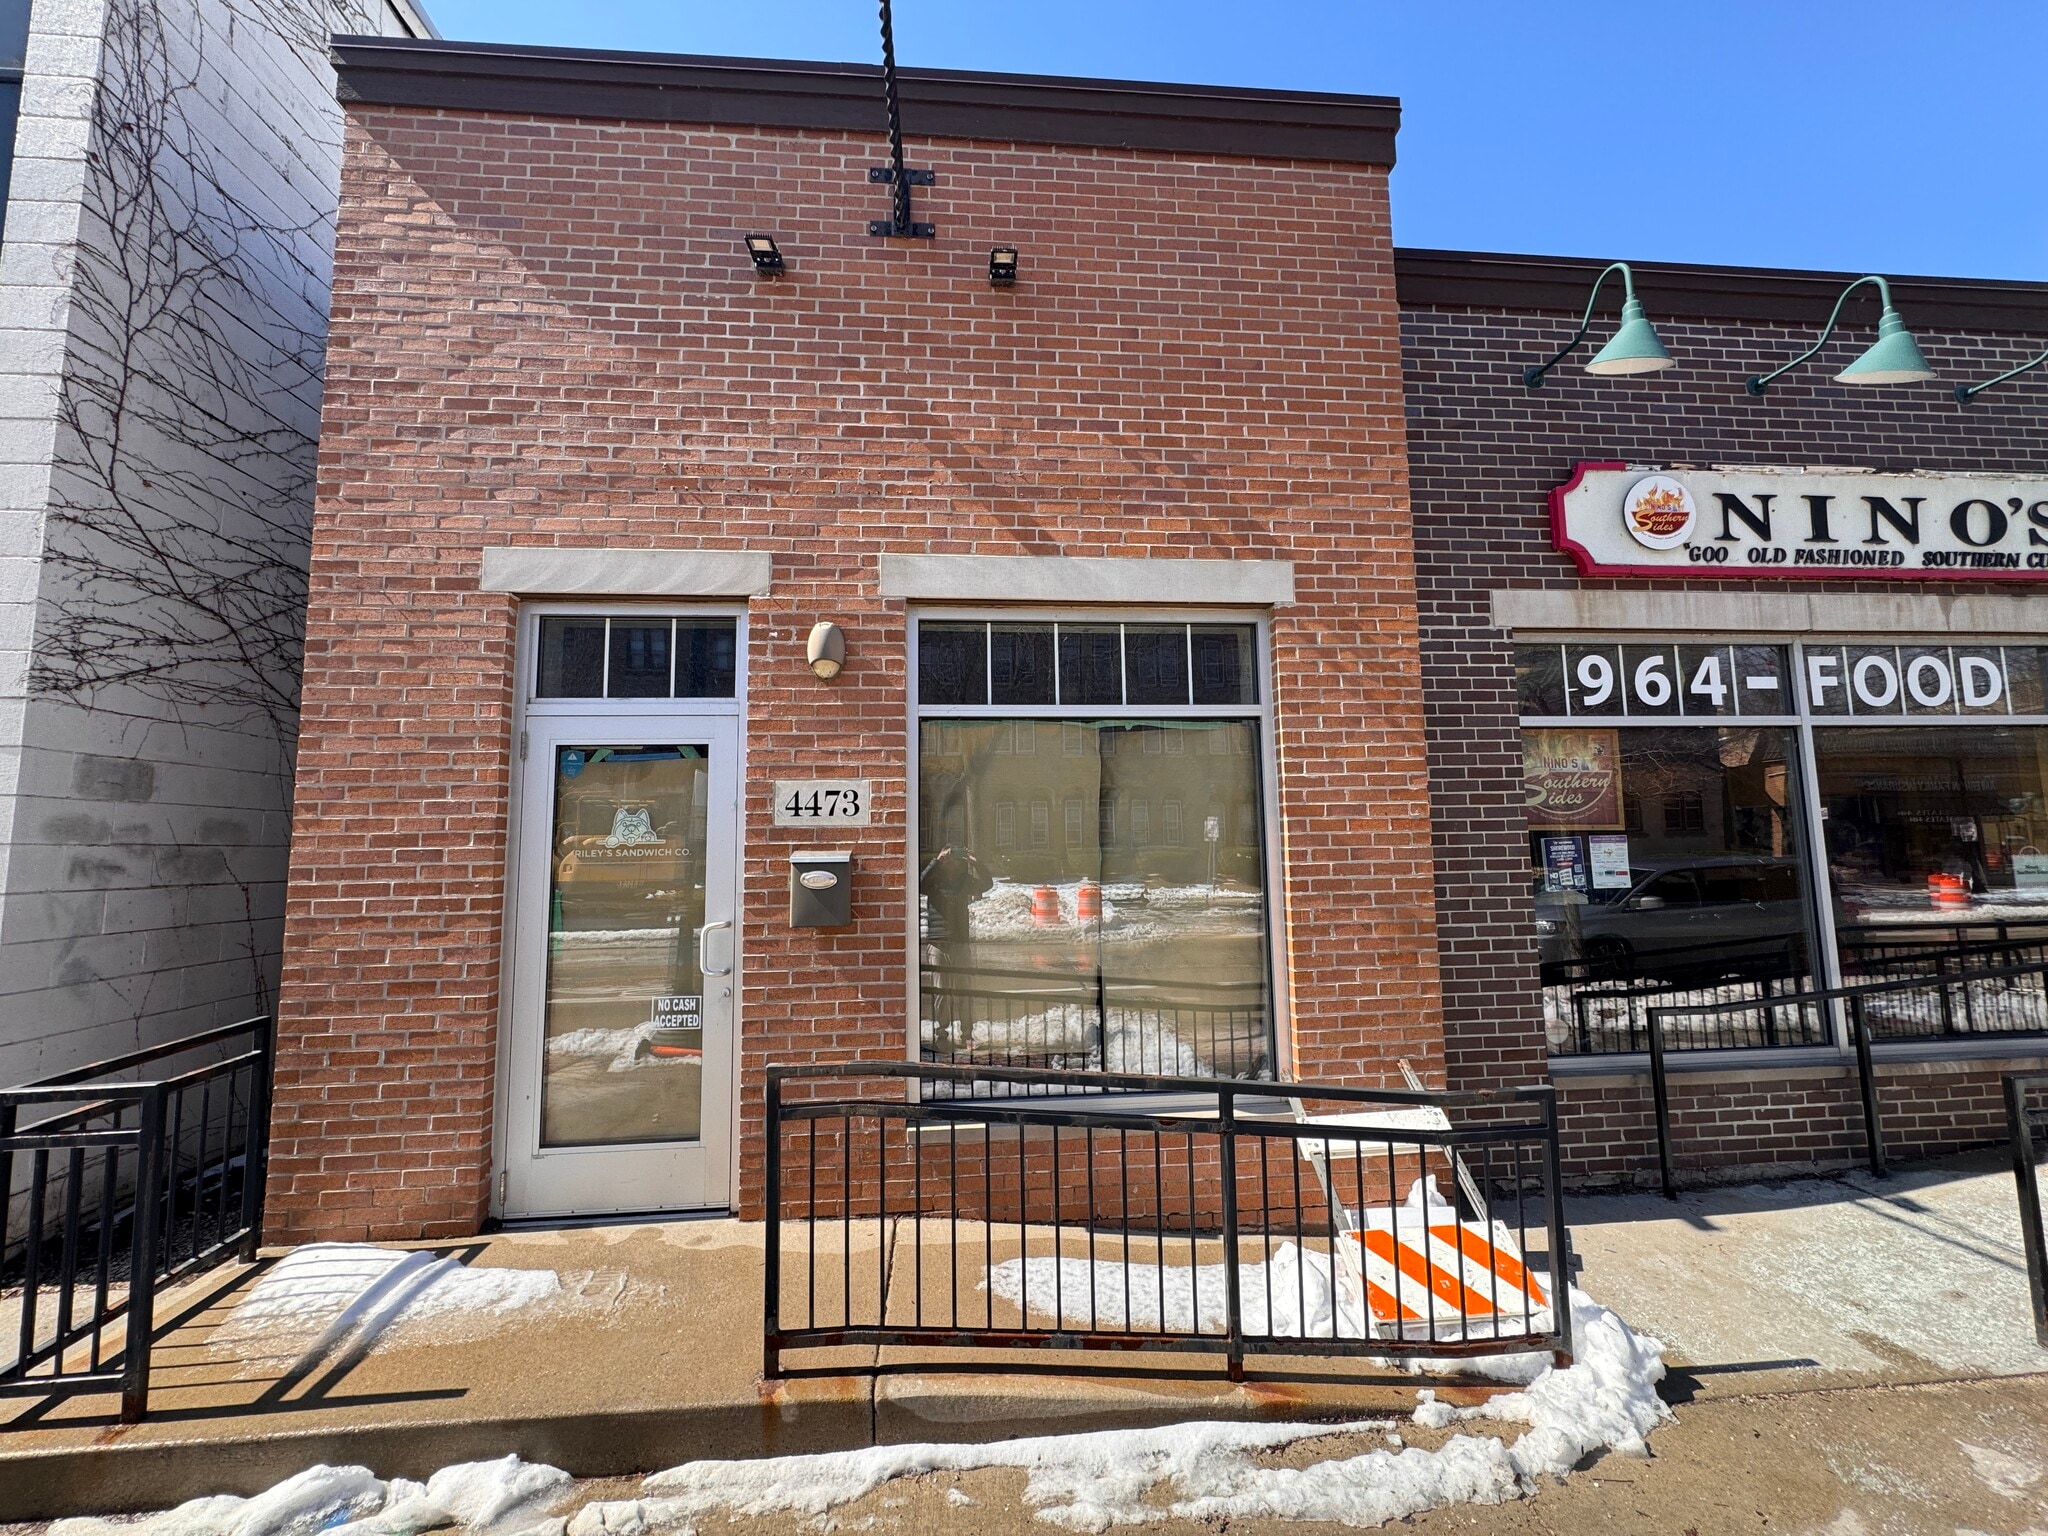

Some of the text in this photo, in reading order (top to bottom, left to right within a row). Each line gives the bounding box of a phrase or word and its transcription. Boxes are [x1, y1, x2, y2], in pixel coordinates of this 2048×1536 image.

[1747, 547, 1787, 564] OLD
[1793, 548, 1905, 566] FASHIONED
[1922, 551, 2021, 568] SOUTHERN
[1807, 655, 2003, 707] FOOD
[785, 789, 860, 818] 4473
[575, 848, 692, 858] RILEY'S SANDWICH CO.
[658, 998, 696, 1011] NO CASH
[653, 1014, 699, 1027] ACCEPTED
